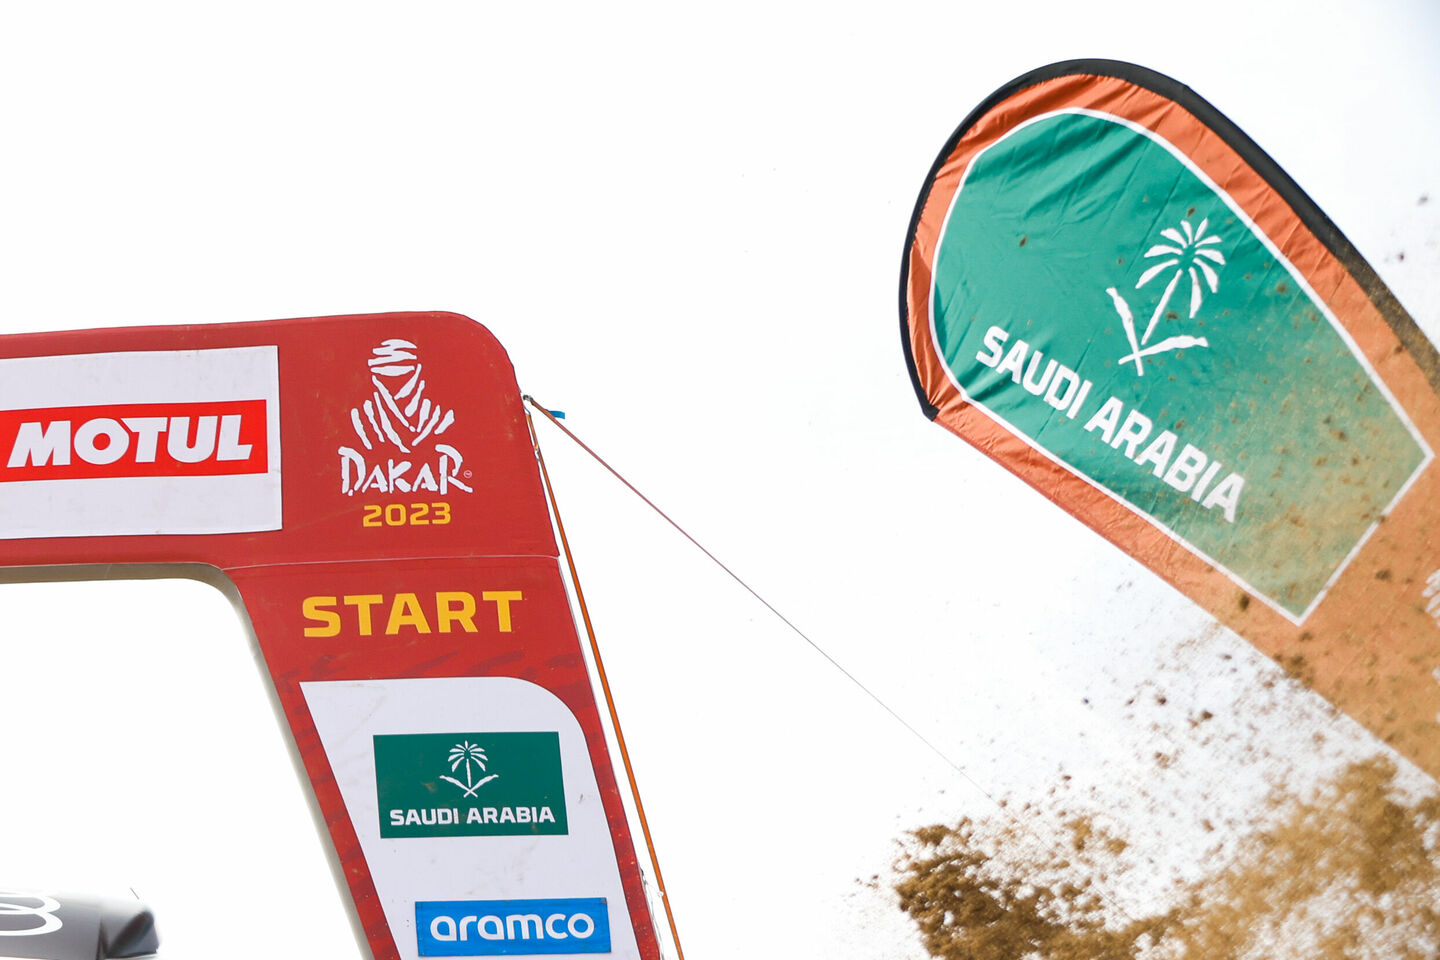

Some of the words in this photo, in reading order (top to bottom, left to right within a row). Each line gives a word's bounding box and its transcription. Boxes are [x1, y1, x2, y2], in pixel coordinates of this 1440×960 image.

[7, 414, 253, 467] MOTUL
[975, 325, 1093, 420] SAUDI
[1083, 395, 1245, 524] ARABIA
[337, 444, 473, 496] DAKAR
[362, 502, 452, 527] 2023
[302, 590, 523, 637] START
[389, 808, 460, 826] SAUDI
[466, 806, 556, 825] ARABIA
[430, 913, 595, 942] aramco
